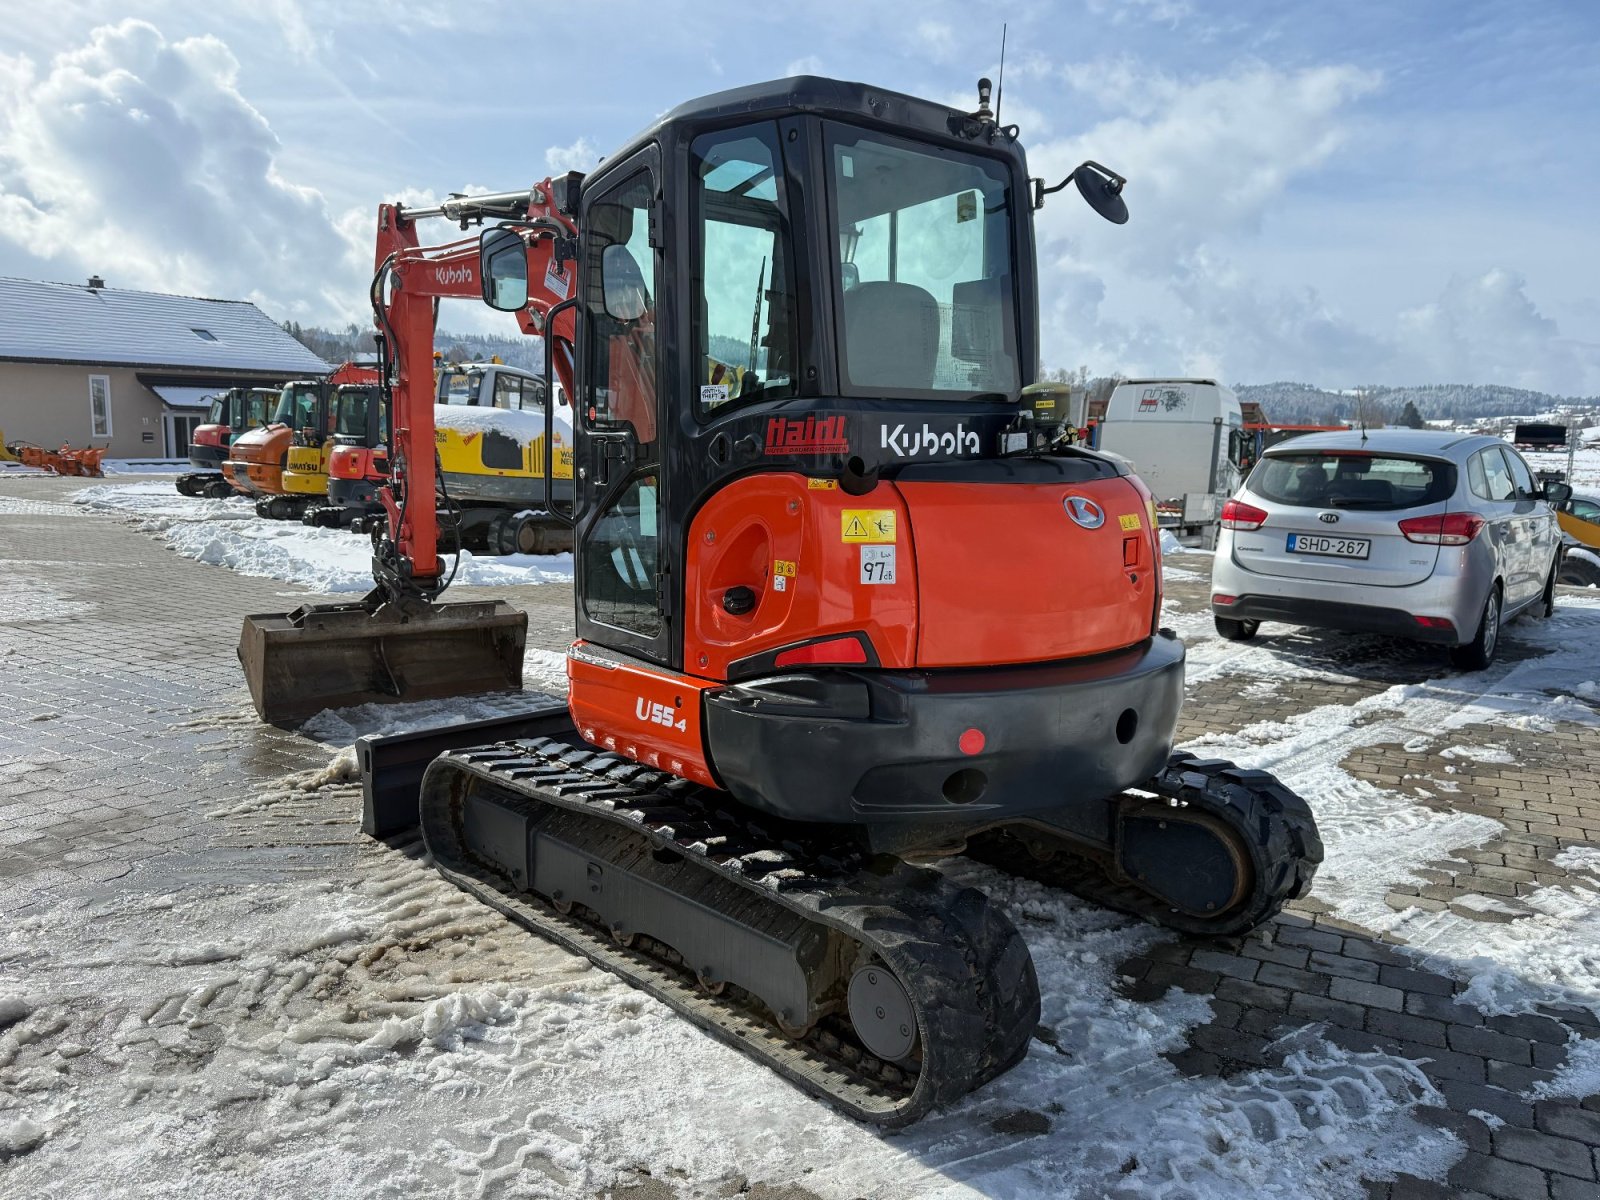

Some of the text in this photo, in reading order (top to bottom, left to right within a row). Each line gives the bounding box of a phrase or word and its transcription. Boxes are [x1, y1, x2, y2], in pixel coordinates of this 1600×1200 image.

[435, 264, 472, 285] Kubota
[765, 415, 848, 446] Haidl
[881, 423, 980, 457] Kubota
[1321, 514, 1337, 522] KIA
[1298, 537, 1366, 554] SHD-267
[864, 562, 885, 581] 97
